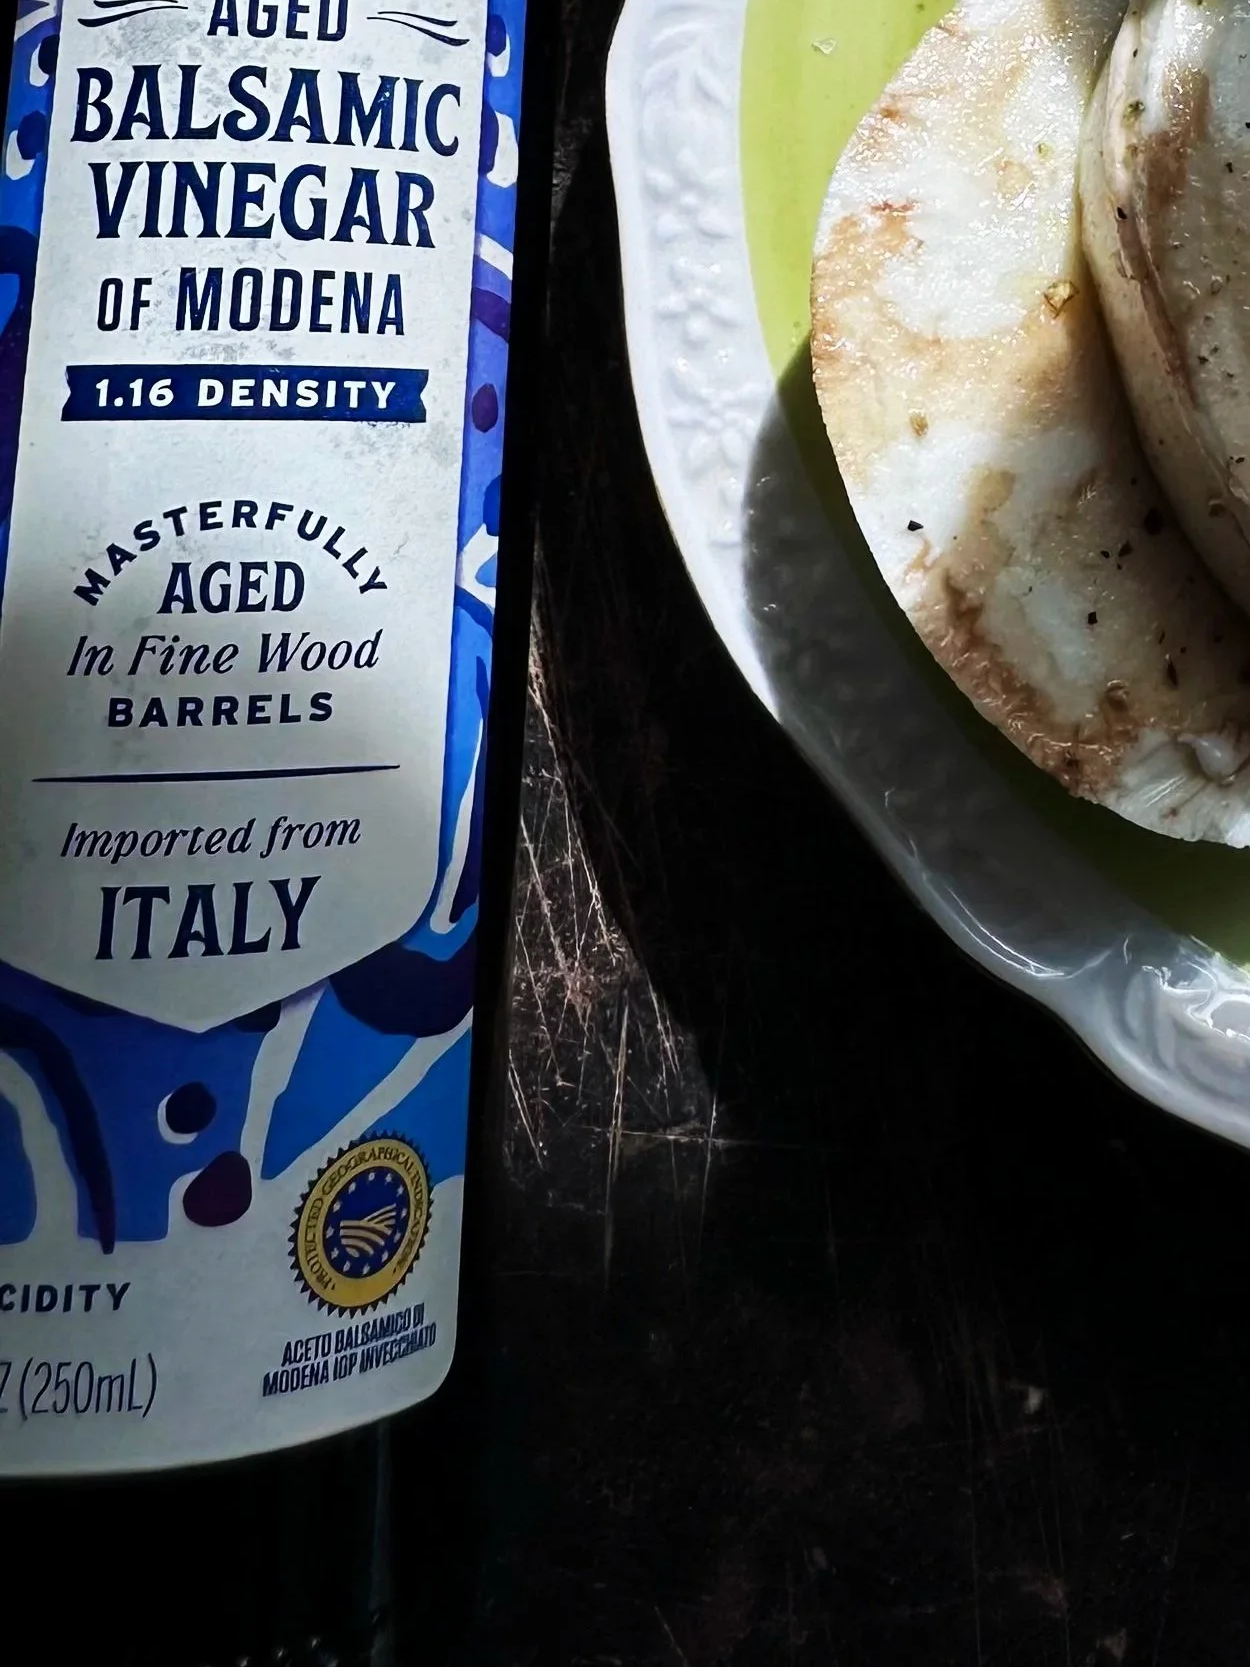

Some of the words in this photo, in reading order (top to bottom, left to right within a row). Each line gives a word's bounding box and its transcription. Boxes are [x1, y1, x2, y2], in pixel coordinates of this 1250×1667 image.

[70, 65, 461, 157] BALSAMIC
[88, 160, 436, 249] VINEGAR
[97, 277, 152, 333] OF
[175, 267, 405, 336] MODENA
[95, 378, 174, 409] 1.16
[198, 379, 396, 410] DENSITY
[73, 499, 388, 608] MASTERFULLY
[157, 560, 305, 615] AGED
[67, 635, 114, 677] In
[128, 634, 239, 676] Fine
[258, 629, 384, 673] Wood
[107, 691, 333, 729] BARRELS
[60, 818, 256, 864] Imported
[260, 816, 362, 859] from
[95, 874, 322, 960] ITALY
[280, 1331, 332, 1368] ACETO
[334, 1306, 412, 1355] BALSAMICO
[412, 1302, 426, 1329] DI
[19, 1352, 157, 1422] (250mL)
[262, 1360, 330, 1398] MODENA
